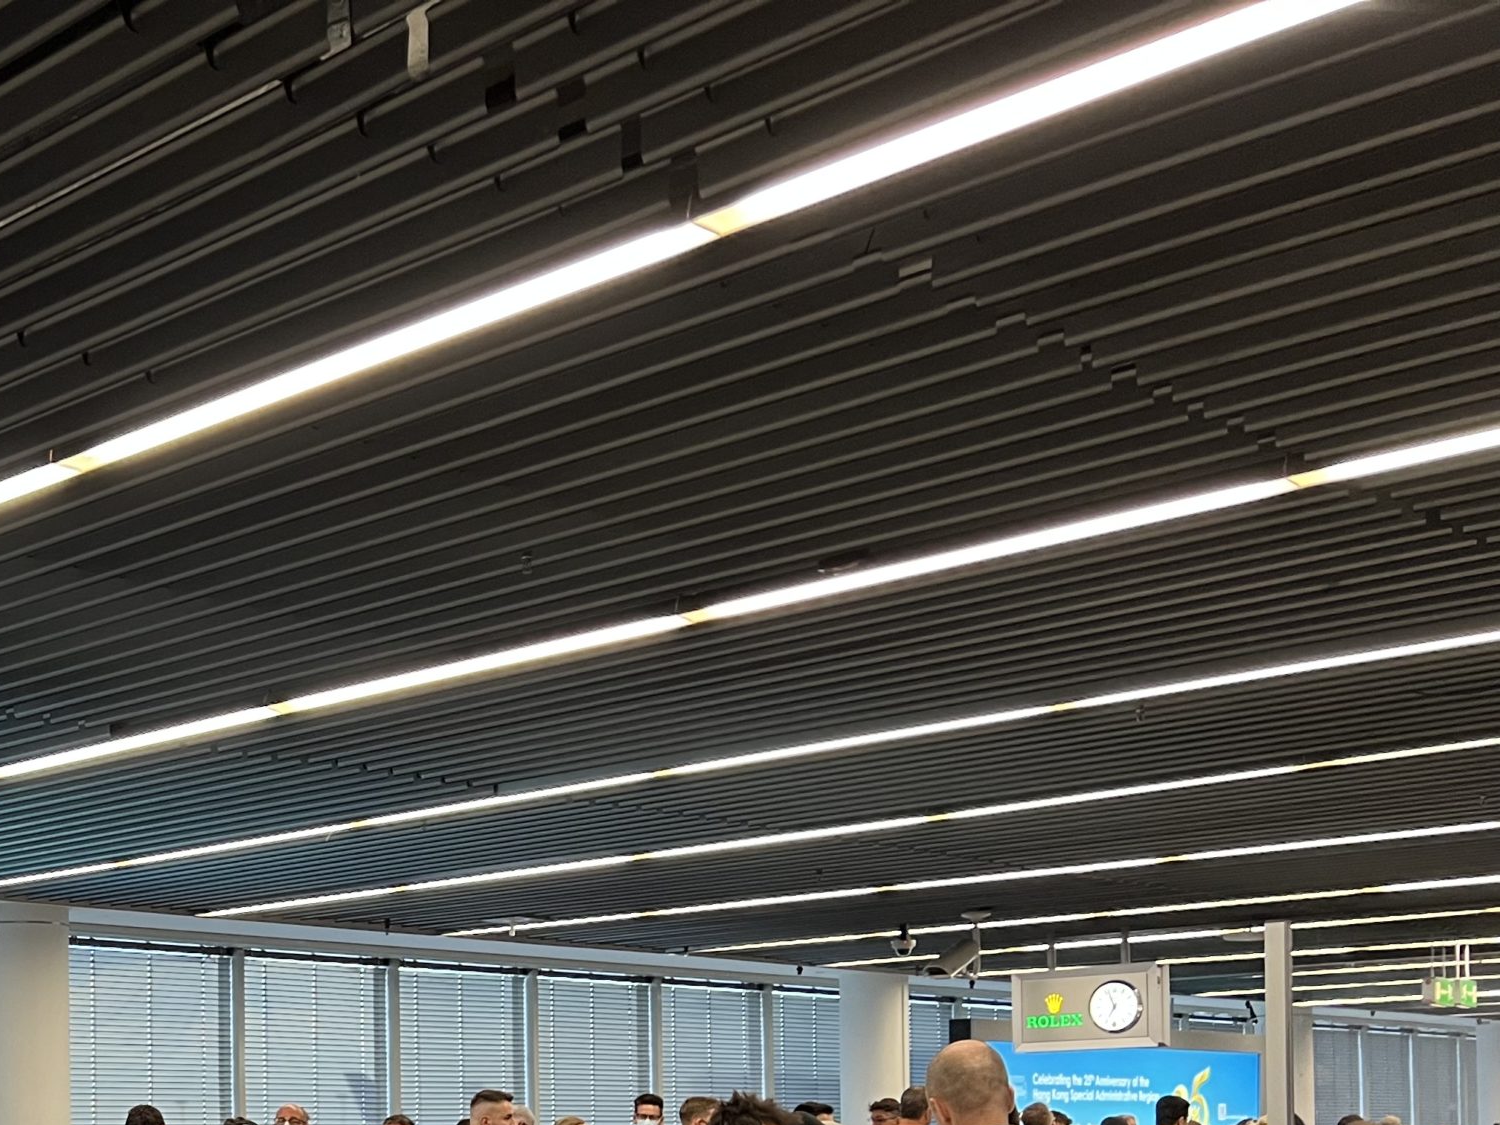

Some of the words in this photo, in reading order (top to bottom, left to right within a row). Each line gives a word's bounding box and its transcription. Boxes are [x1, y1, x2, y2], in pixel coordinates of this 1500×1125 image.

[1026, 1013, 1084, 1030] ROLEX
[1032, 1072, 1071, 1088] Celebrating
[1072, 1073, 1082, 1086] the
[1095, 1075, 1131, 1091] Anniversary
[1131, 1076, 1140, 1088] of
[1139, 1076, 1150, 1088] the
[1032, 1088, 1051, 1104] Hong
[1051, 1088, 1069, 1103] Kong
[1070, 1089, 1094, 1102] Special
[1094, 1089, 1137, 1102] Administrative
